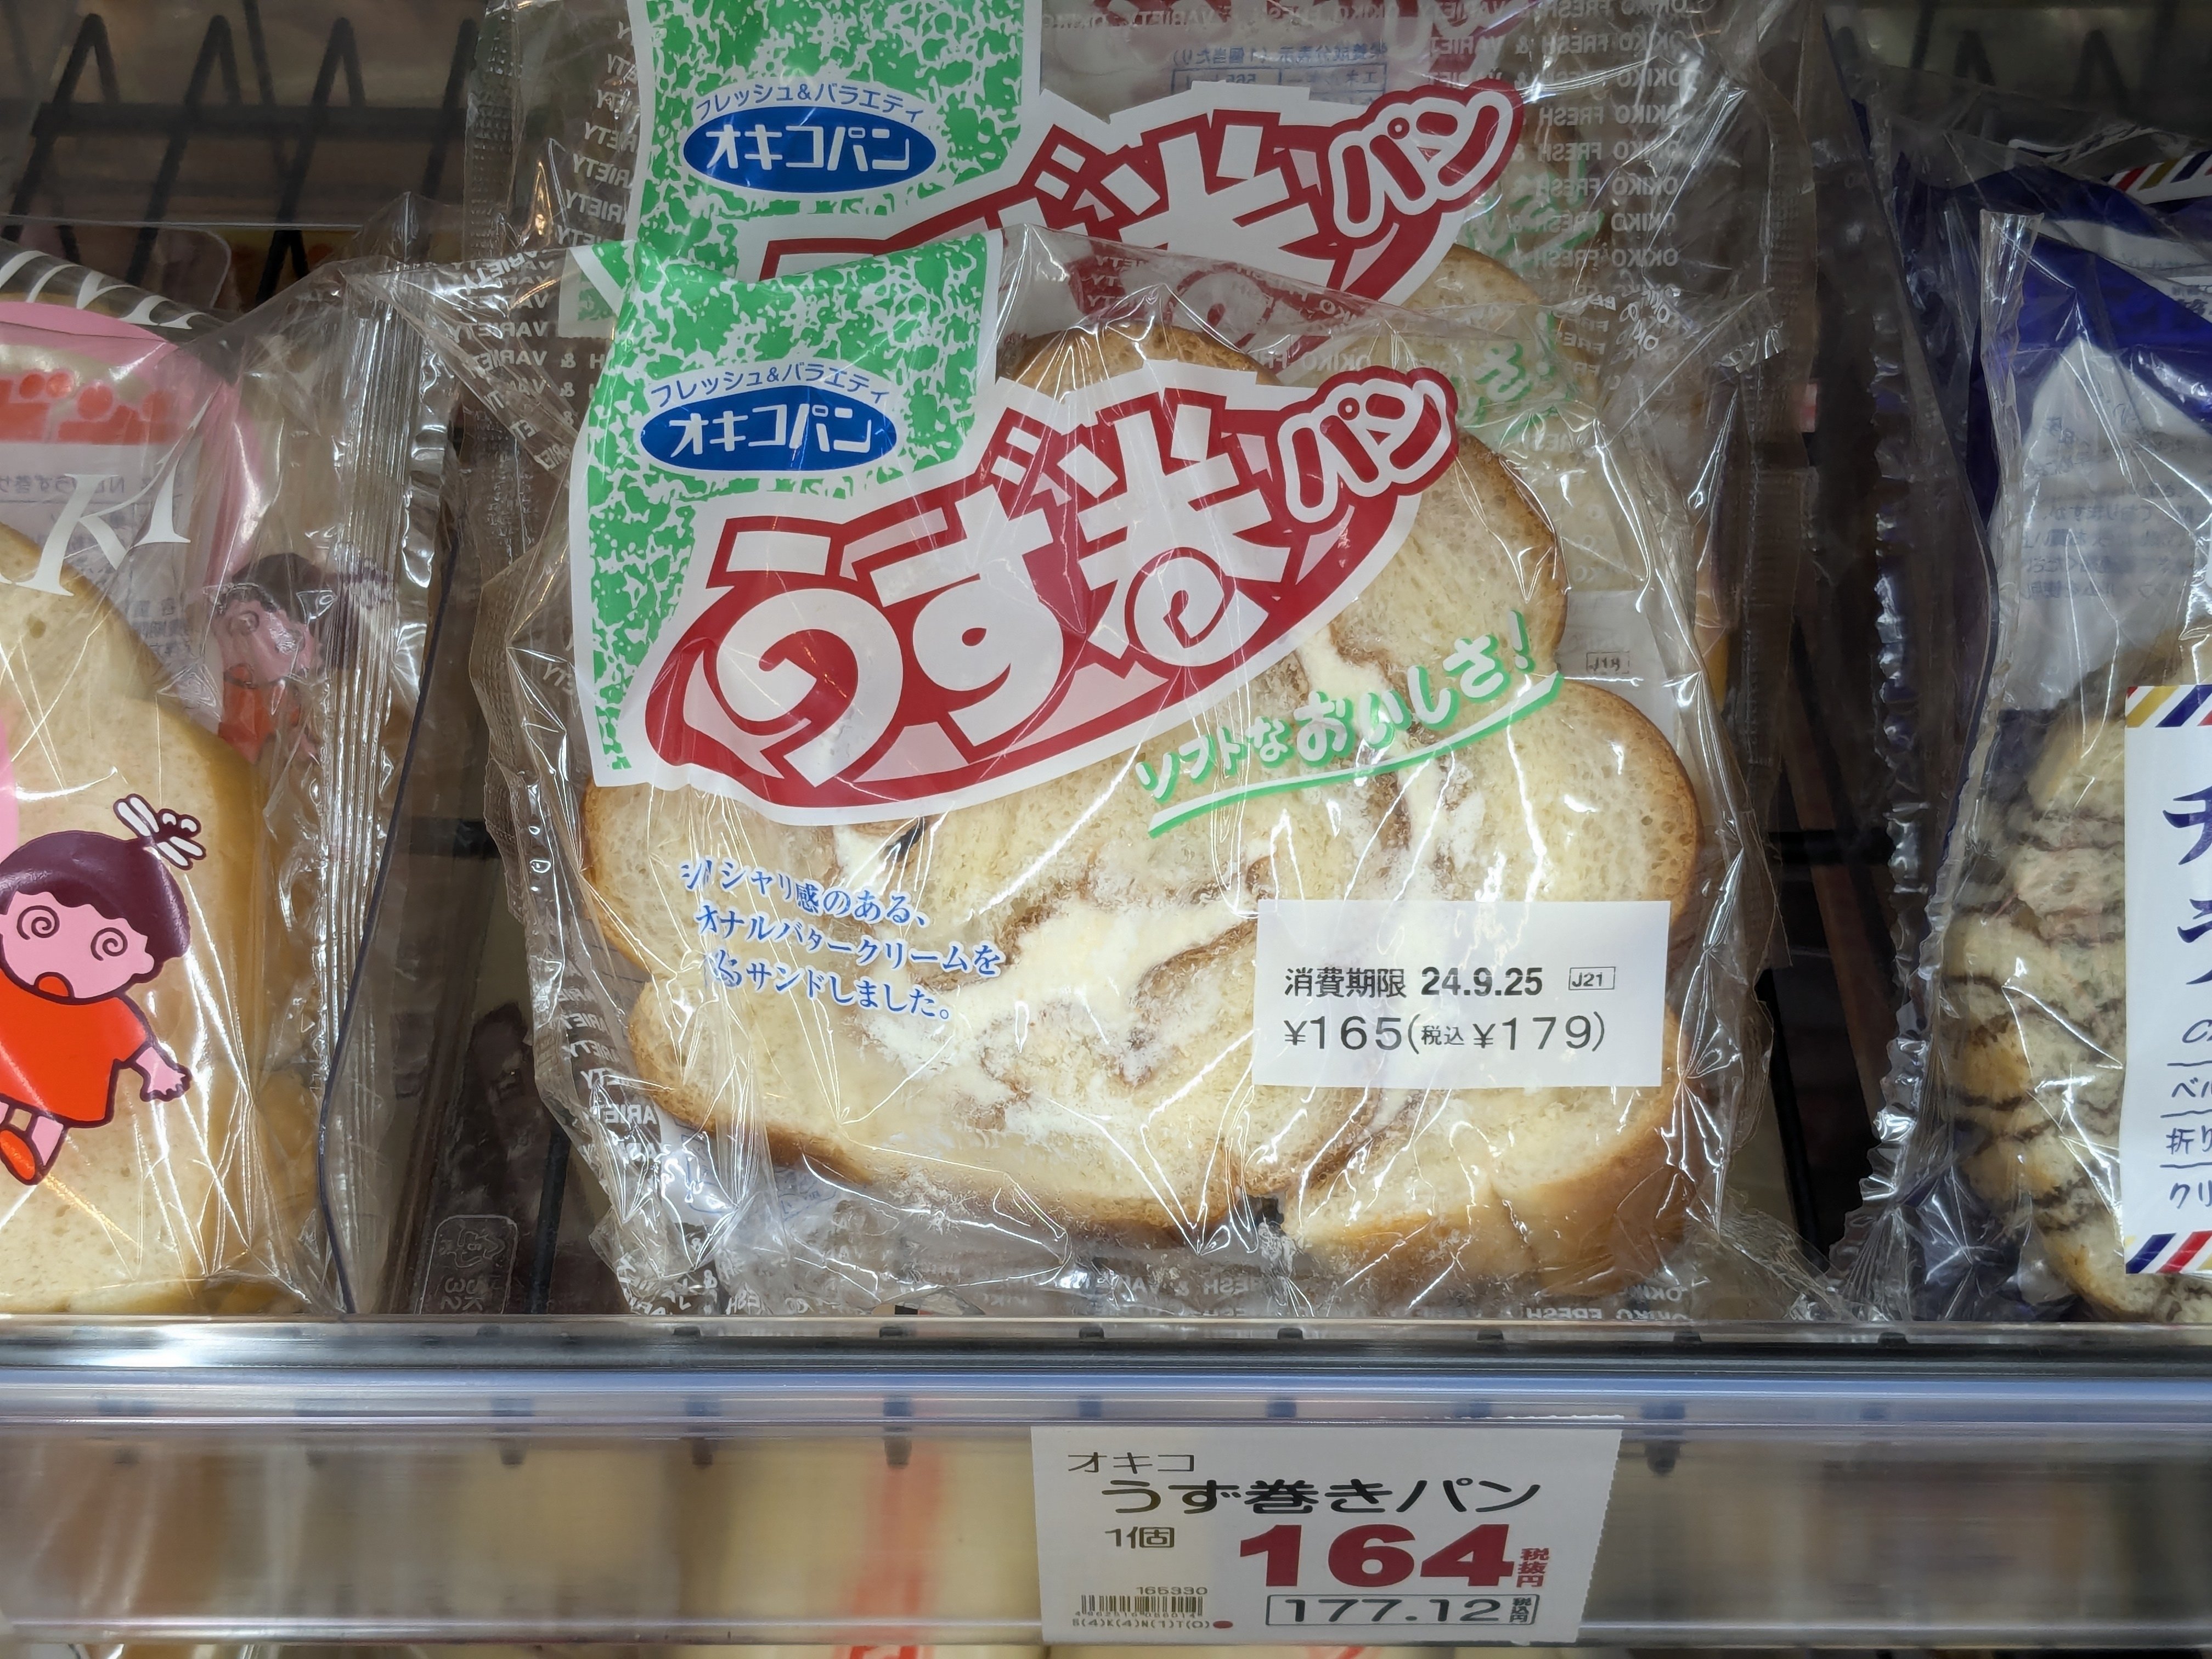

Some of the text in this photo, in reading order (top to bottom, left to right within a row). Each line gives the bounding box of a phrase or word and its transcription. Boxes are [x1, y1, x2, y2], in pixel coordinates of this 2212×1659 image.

[696, 82, 924, 120] フレッシュ&バラエティ
[705, 124, 911, 172] オキコパン
[651, 362, 891, 408] フレッシュ&バラエティ
[669, 403, 871, 457] オキコパン
[1135, 608, 1534, 803] ソフトなおいしさ!
[1284, 967, 1543, 998] 消費期限 24.9.25
[1572, 971, 1604, 988] J21
[1068, 1452, 1195, 1474] オキコ
[1101, 1477, 1541, 1514] うず巻きパン
[1104, 1526, 1176, 1550] 1個
[1240, 1523, 1515, 1588] 164
[1516, 1547, 1550, 1588] 税抜円
[1285, 1599, 1501, 1623] 177.12
[1509, 1596, 1532, 1623] 税込円
